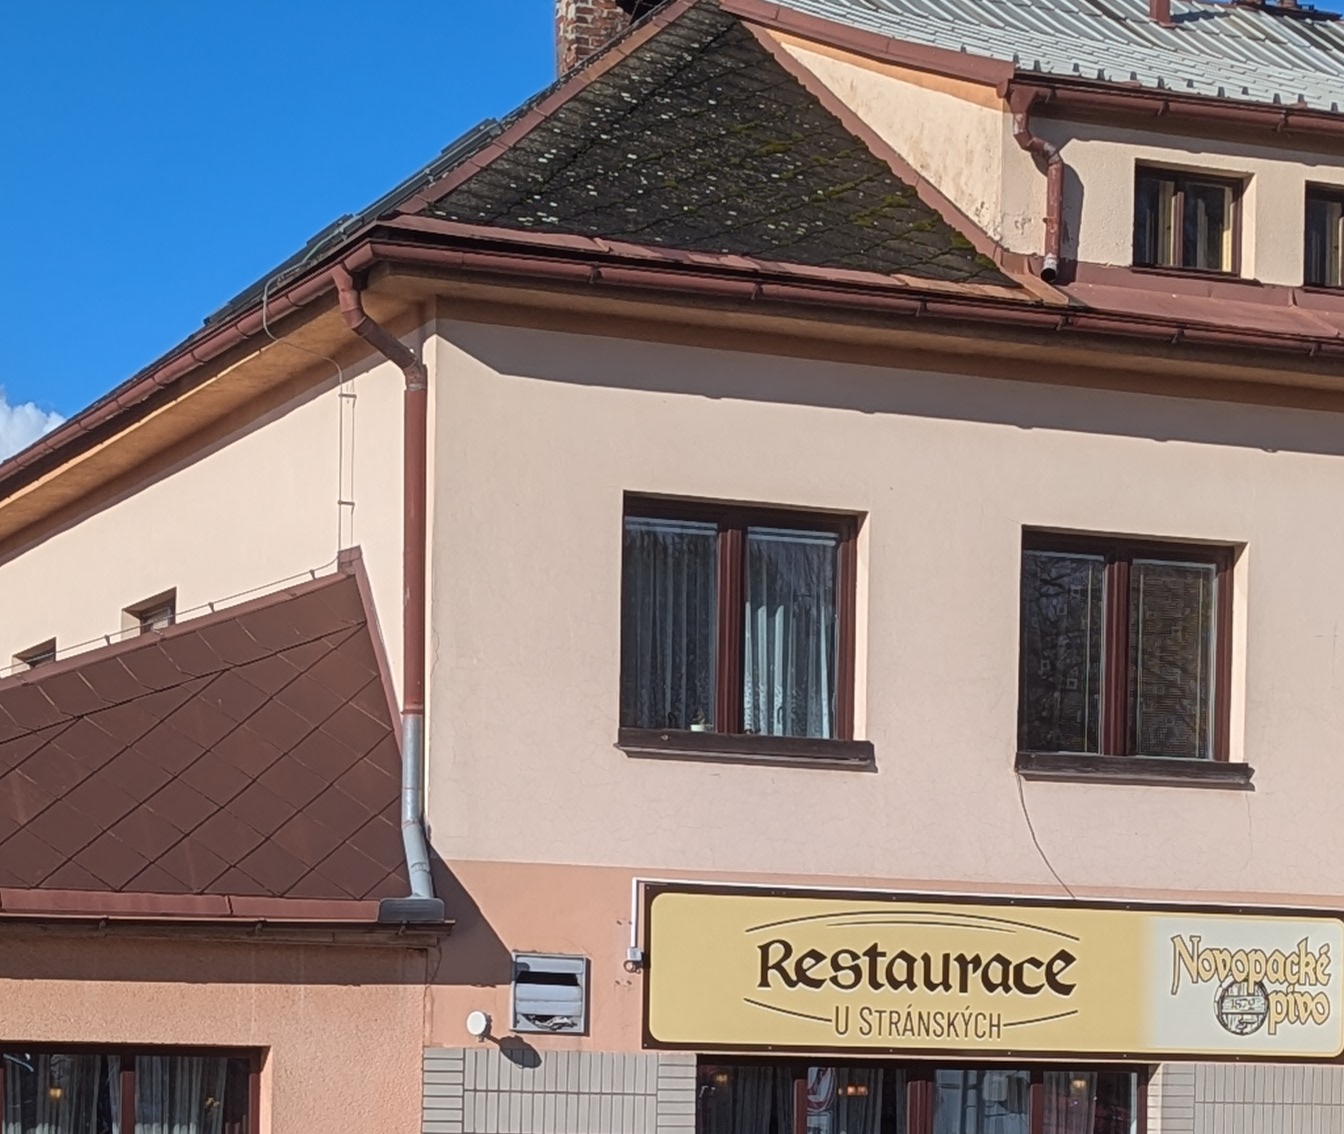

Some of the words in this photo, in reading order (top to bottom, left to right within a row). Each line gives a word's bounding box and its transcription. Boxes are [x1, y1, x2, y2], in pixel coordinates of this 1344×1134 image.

[757, 938, 1077, 996] Restaurace
[1170, 934, 1332, 996] Novopacké
[835, 1005, 850, 1036] U
[1267, 984, 1331, 1035] pivo
